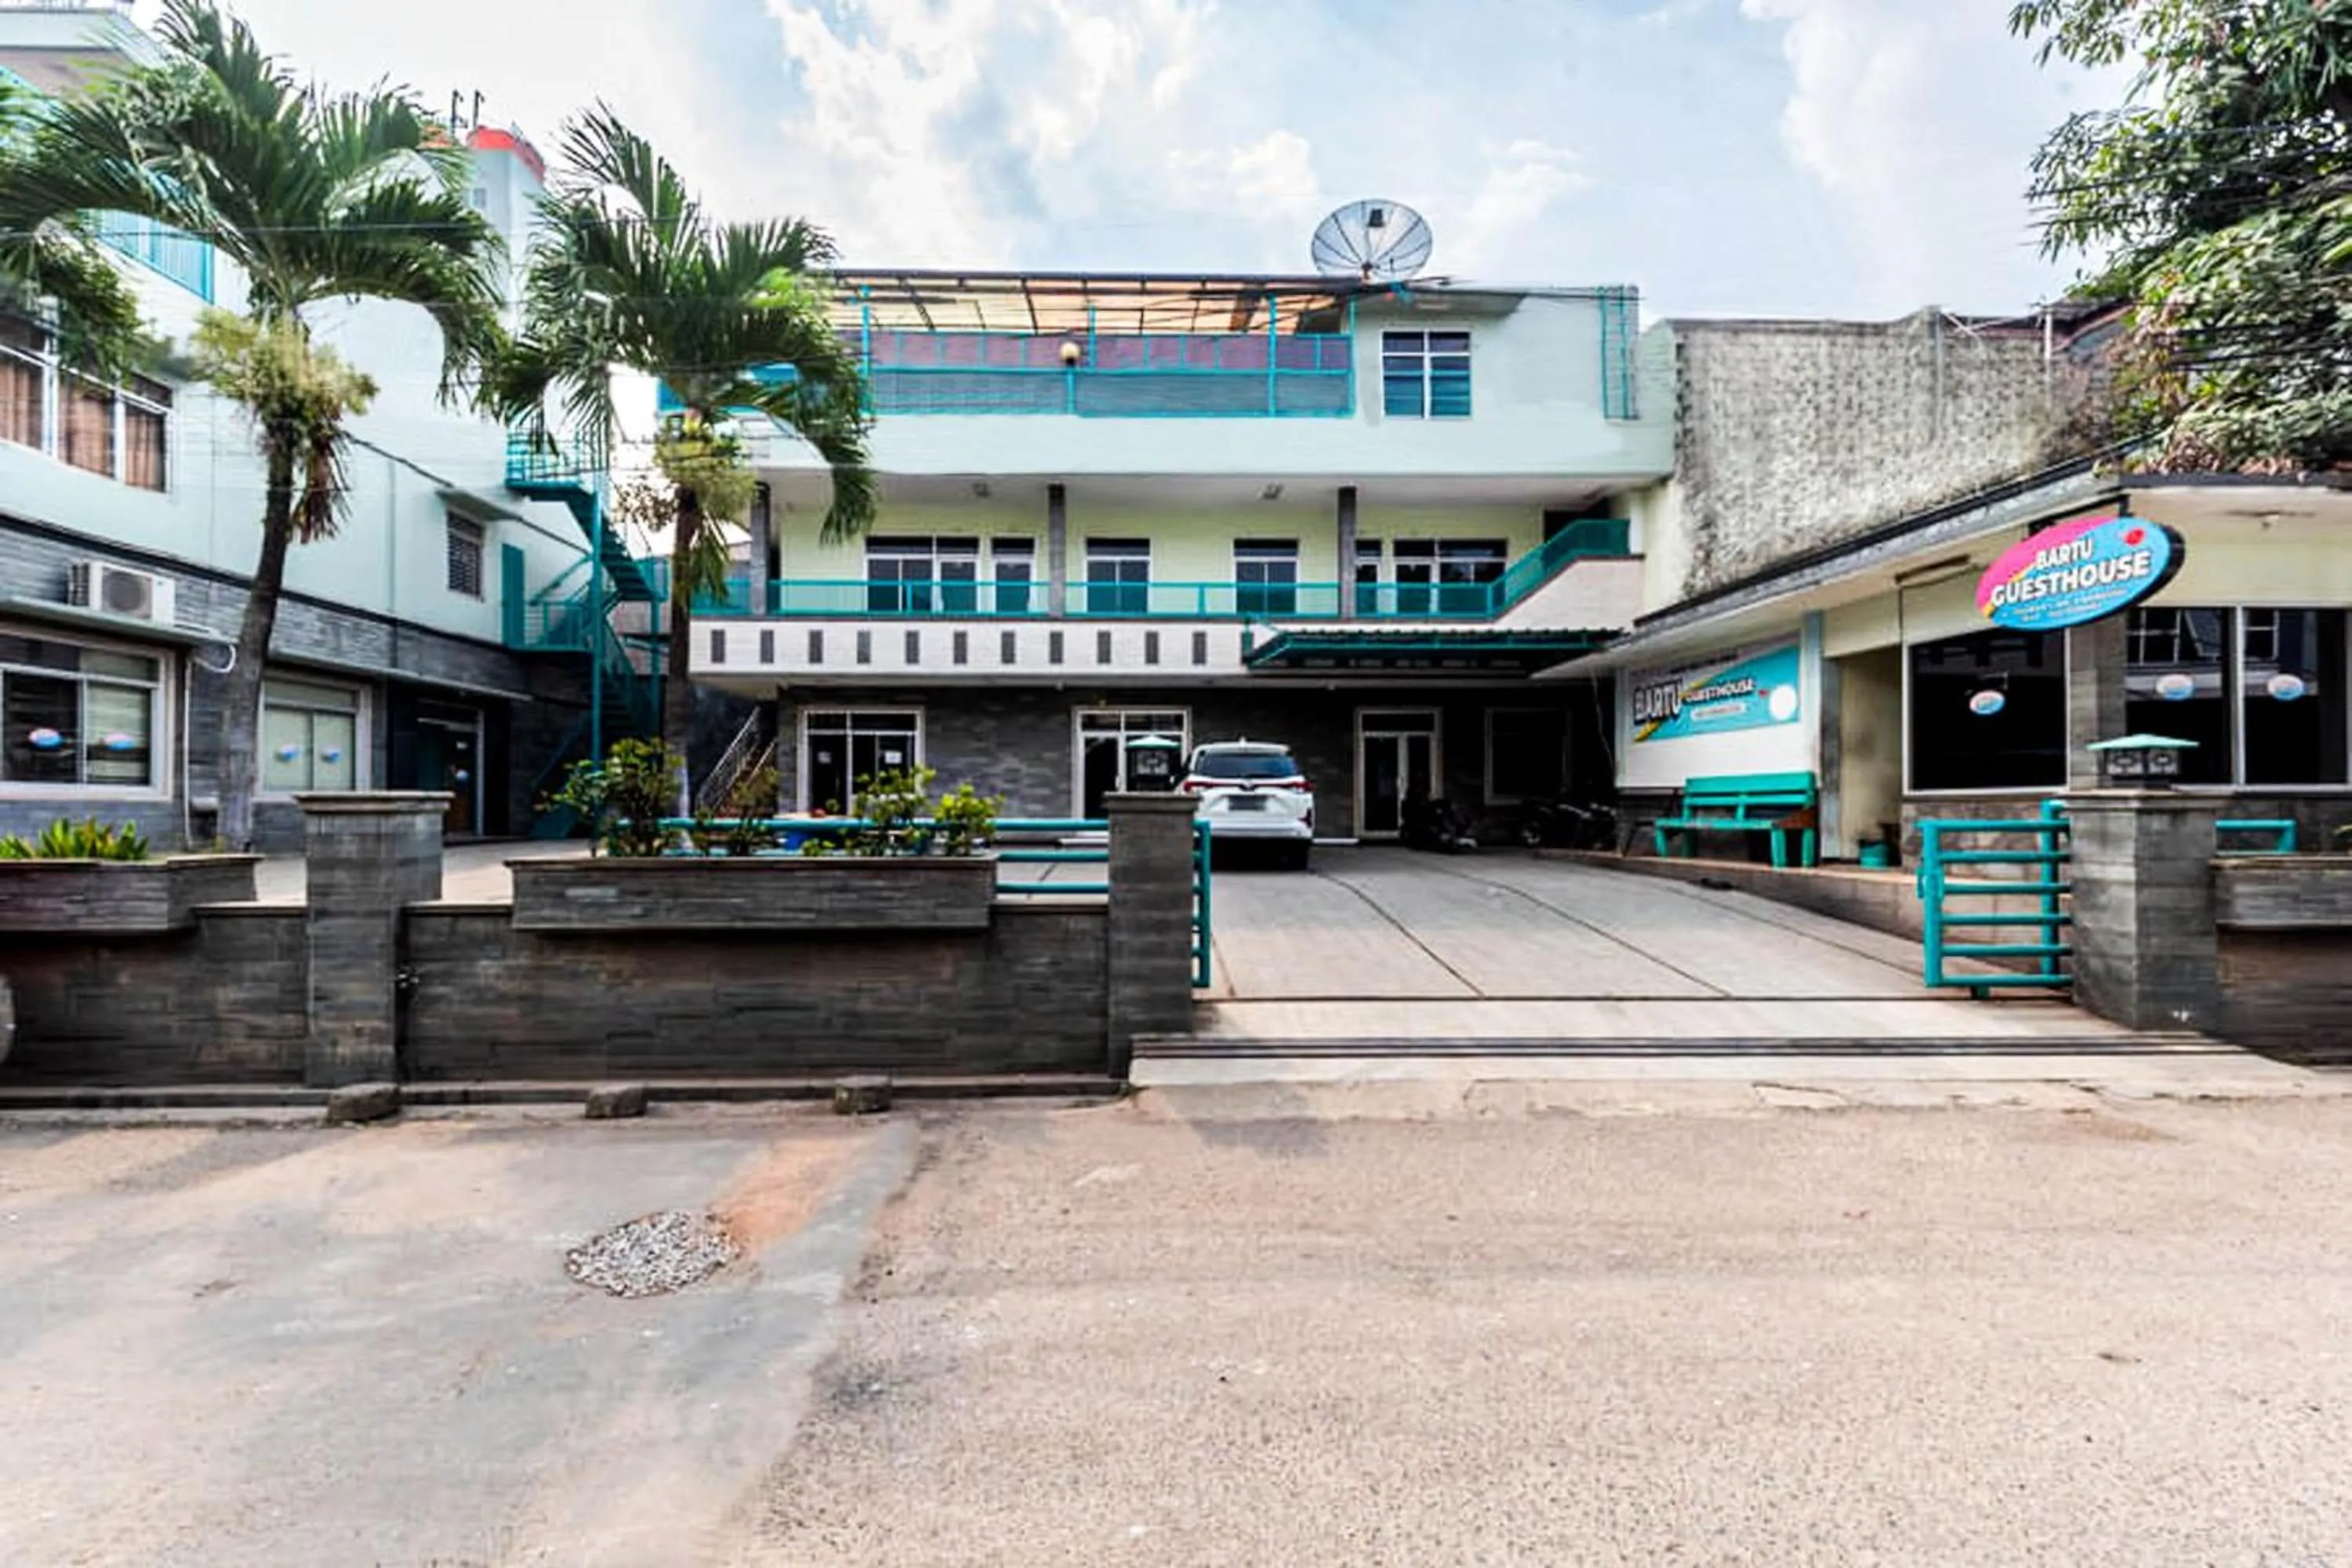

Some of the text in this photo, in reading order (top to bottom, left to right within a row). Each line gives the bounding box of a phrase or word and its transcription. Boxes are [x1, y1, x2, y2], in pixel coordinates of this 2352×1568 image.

[2034, 538, 2092, 568] BARTU
[1991, 550, 2151, 607] GUESTHOUSE
[1635, 681, 1682, 720] BARTU
